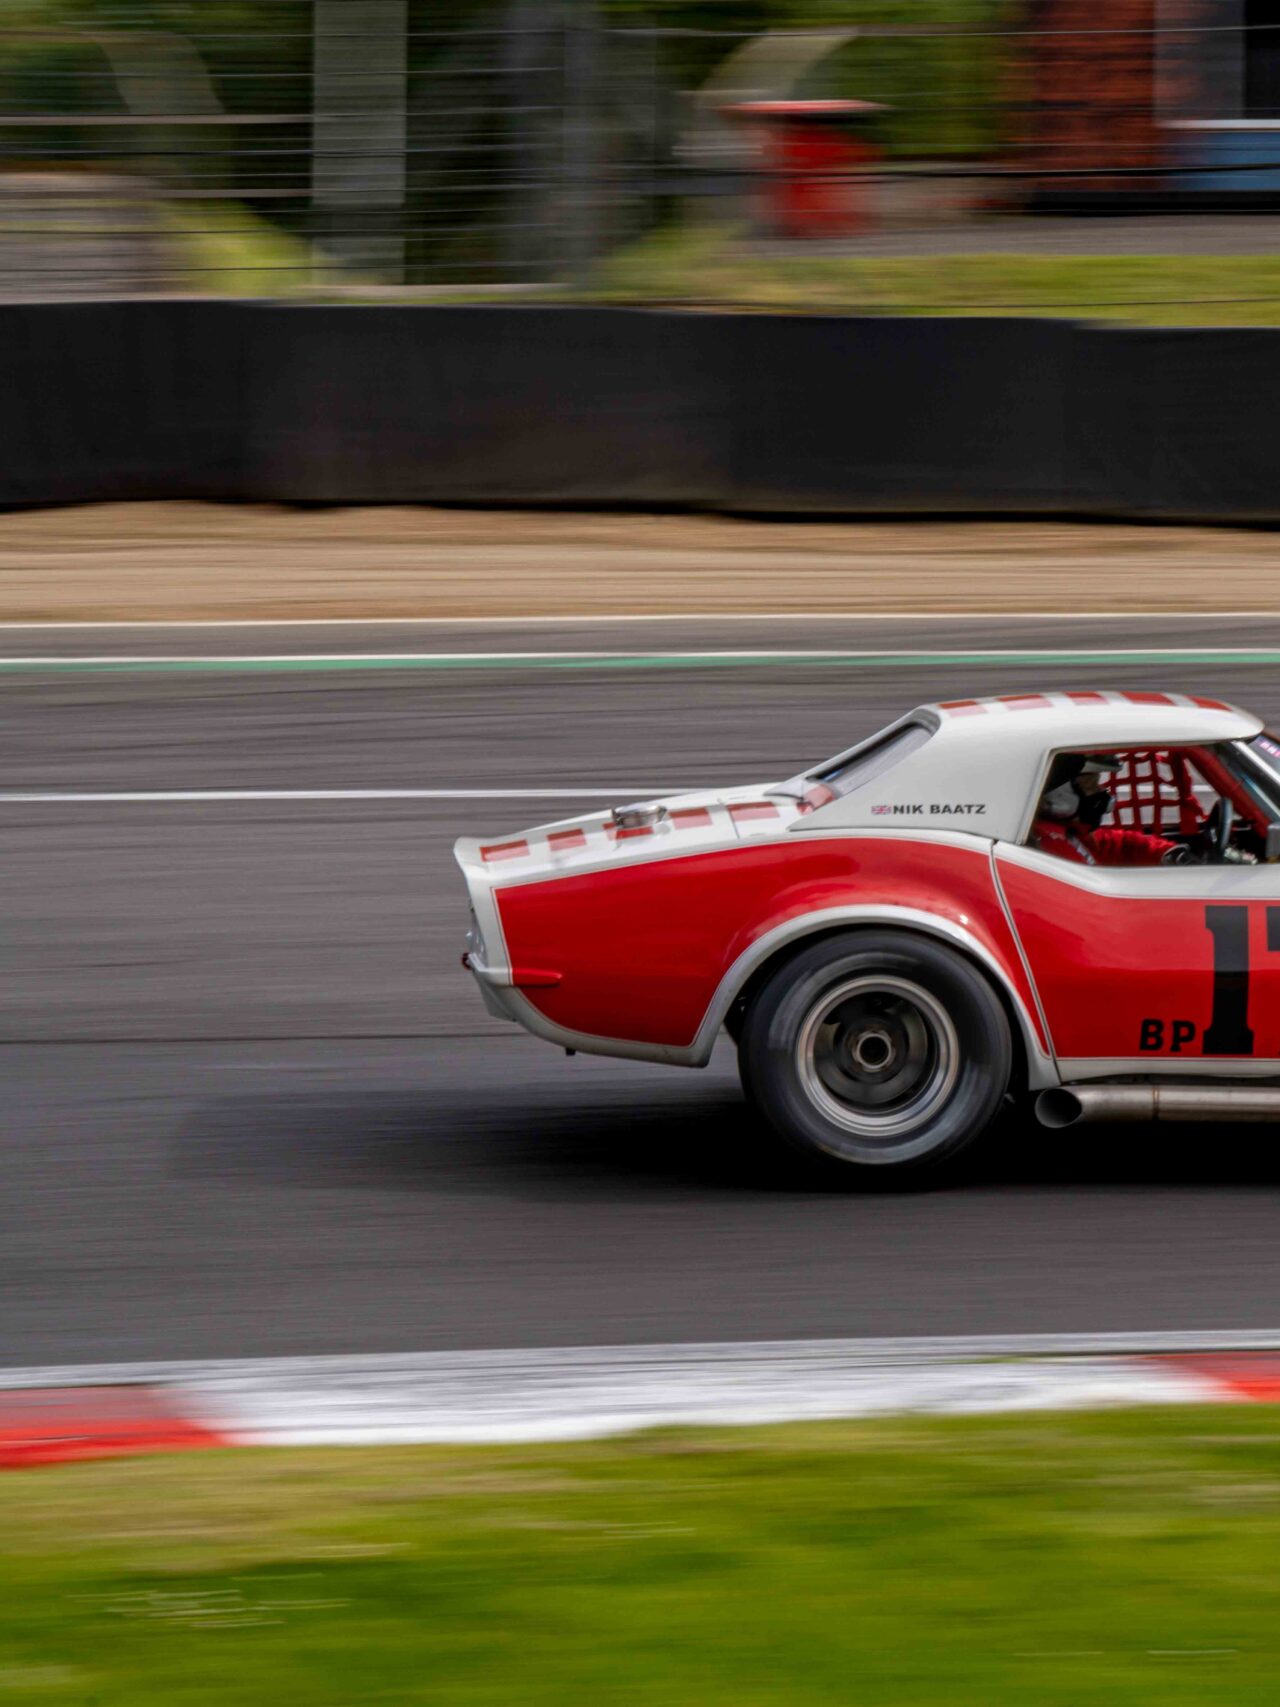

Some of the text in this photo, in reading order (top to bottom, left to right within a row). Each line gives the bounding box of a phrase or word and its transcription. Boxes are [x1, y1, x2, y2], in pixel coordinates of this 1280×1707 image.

[893, 804, 986, 815] NIK BAATZ
[1139, 1018, 1196, 1052] BP
